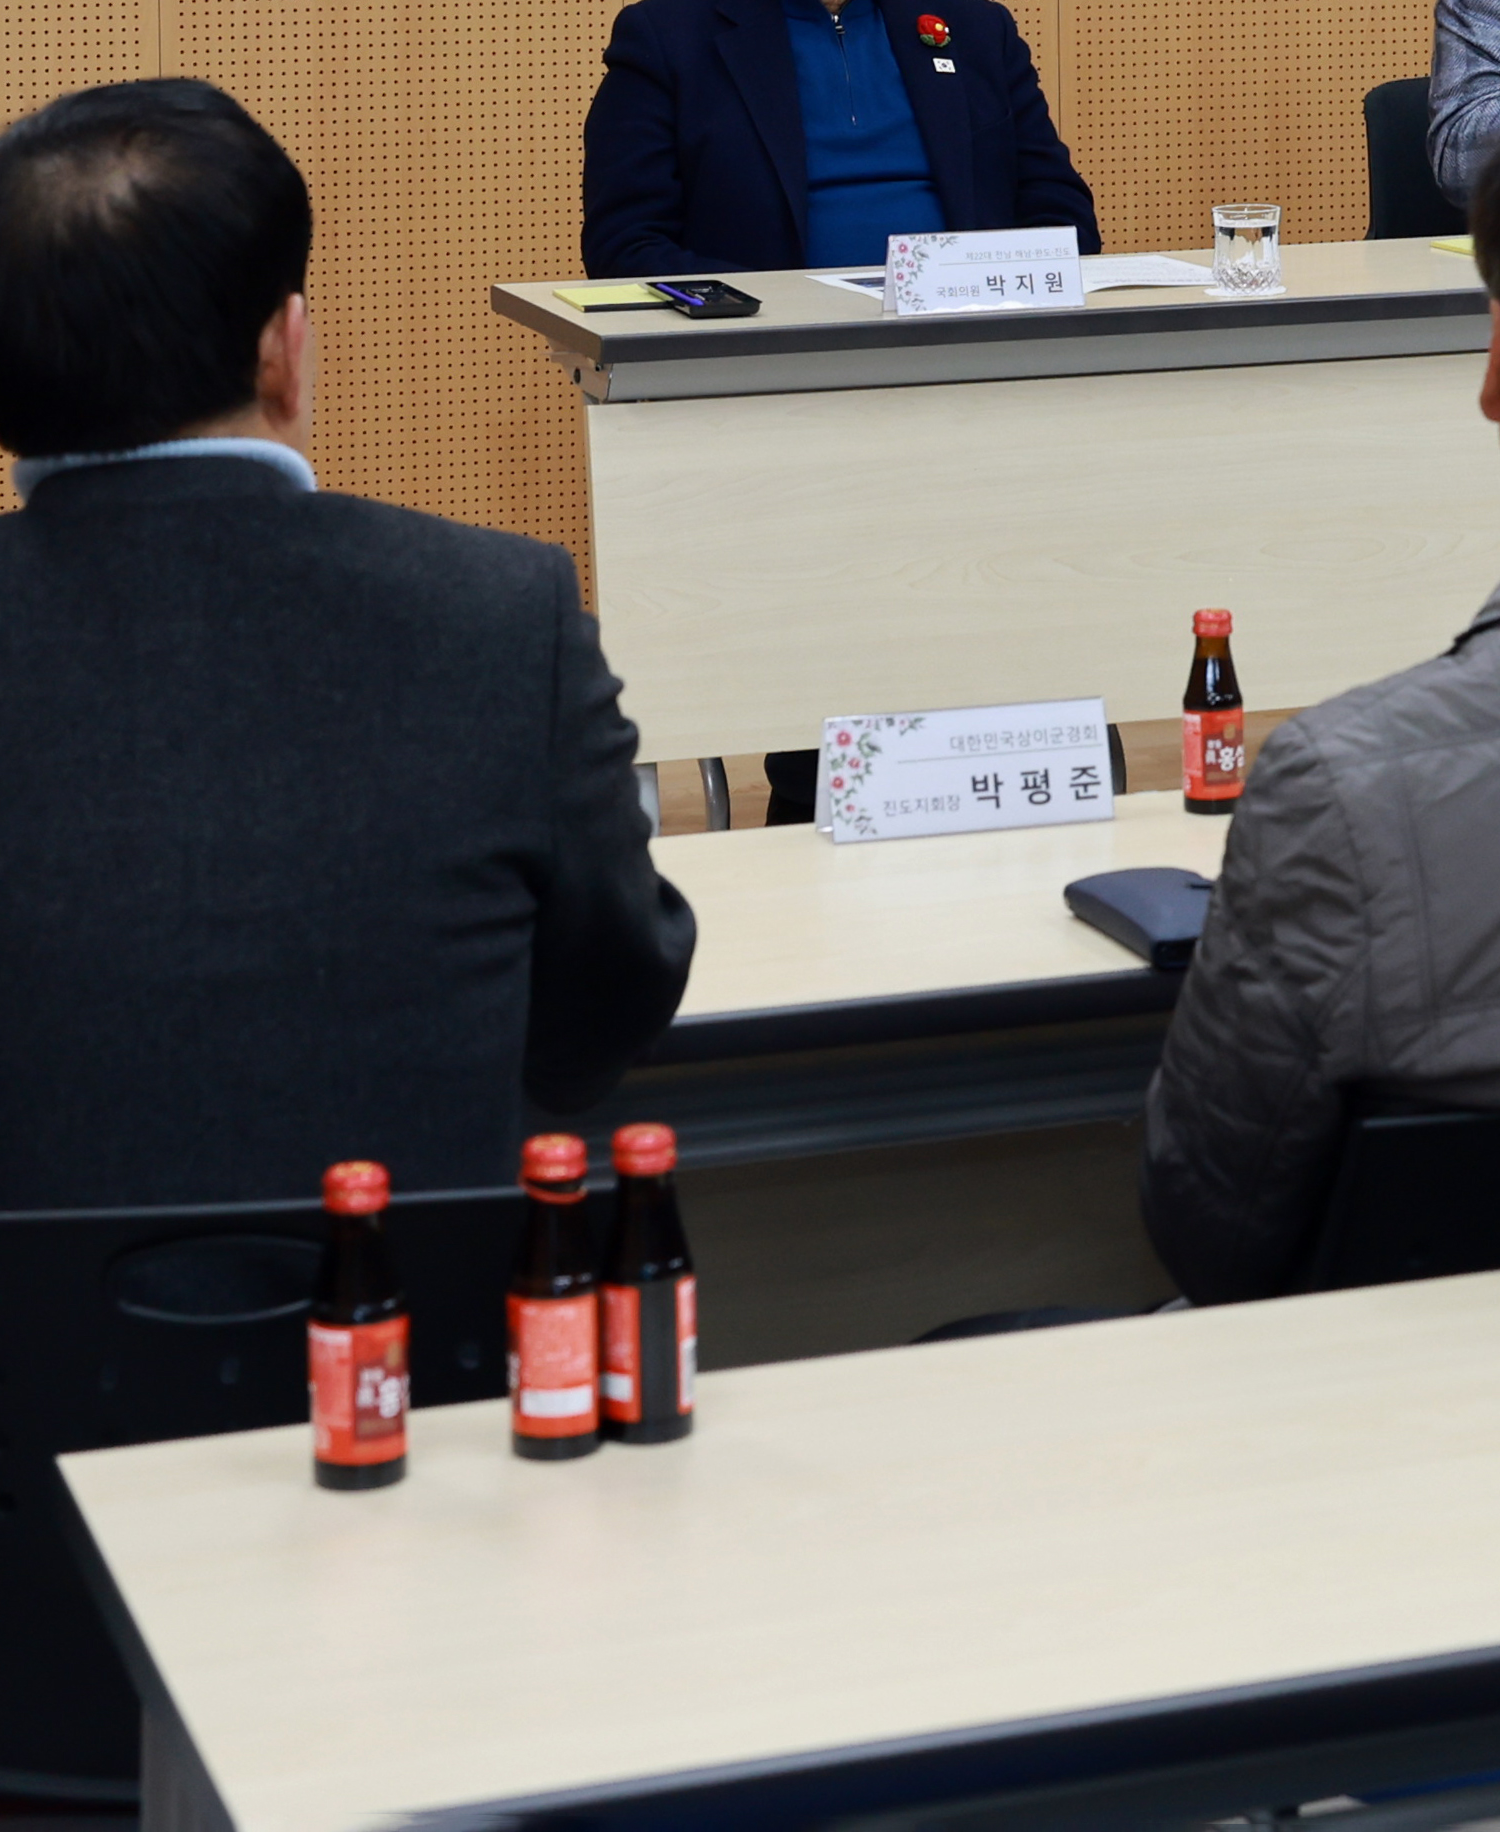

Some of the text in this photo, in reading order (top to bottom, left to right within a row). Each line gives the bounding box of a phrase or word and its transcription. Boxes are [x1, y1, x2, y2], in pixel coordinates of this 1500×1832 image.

[966, 252, 992, 261] 제22대
[995, 250, 1012, 260] 전남
[936, 284, 980, 299] 국회의원
[986, 271, 1064, 297] 박지원
[950, 723, 1099, 753] 대한민국상이군경회
[883, 765, 1102, 818] 진도지회장 박평준
